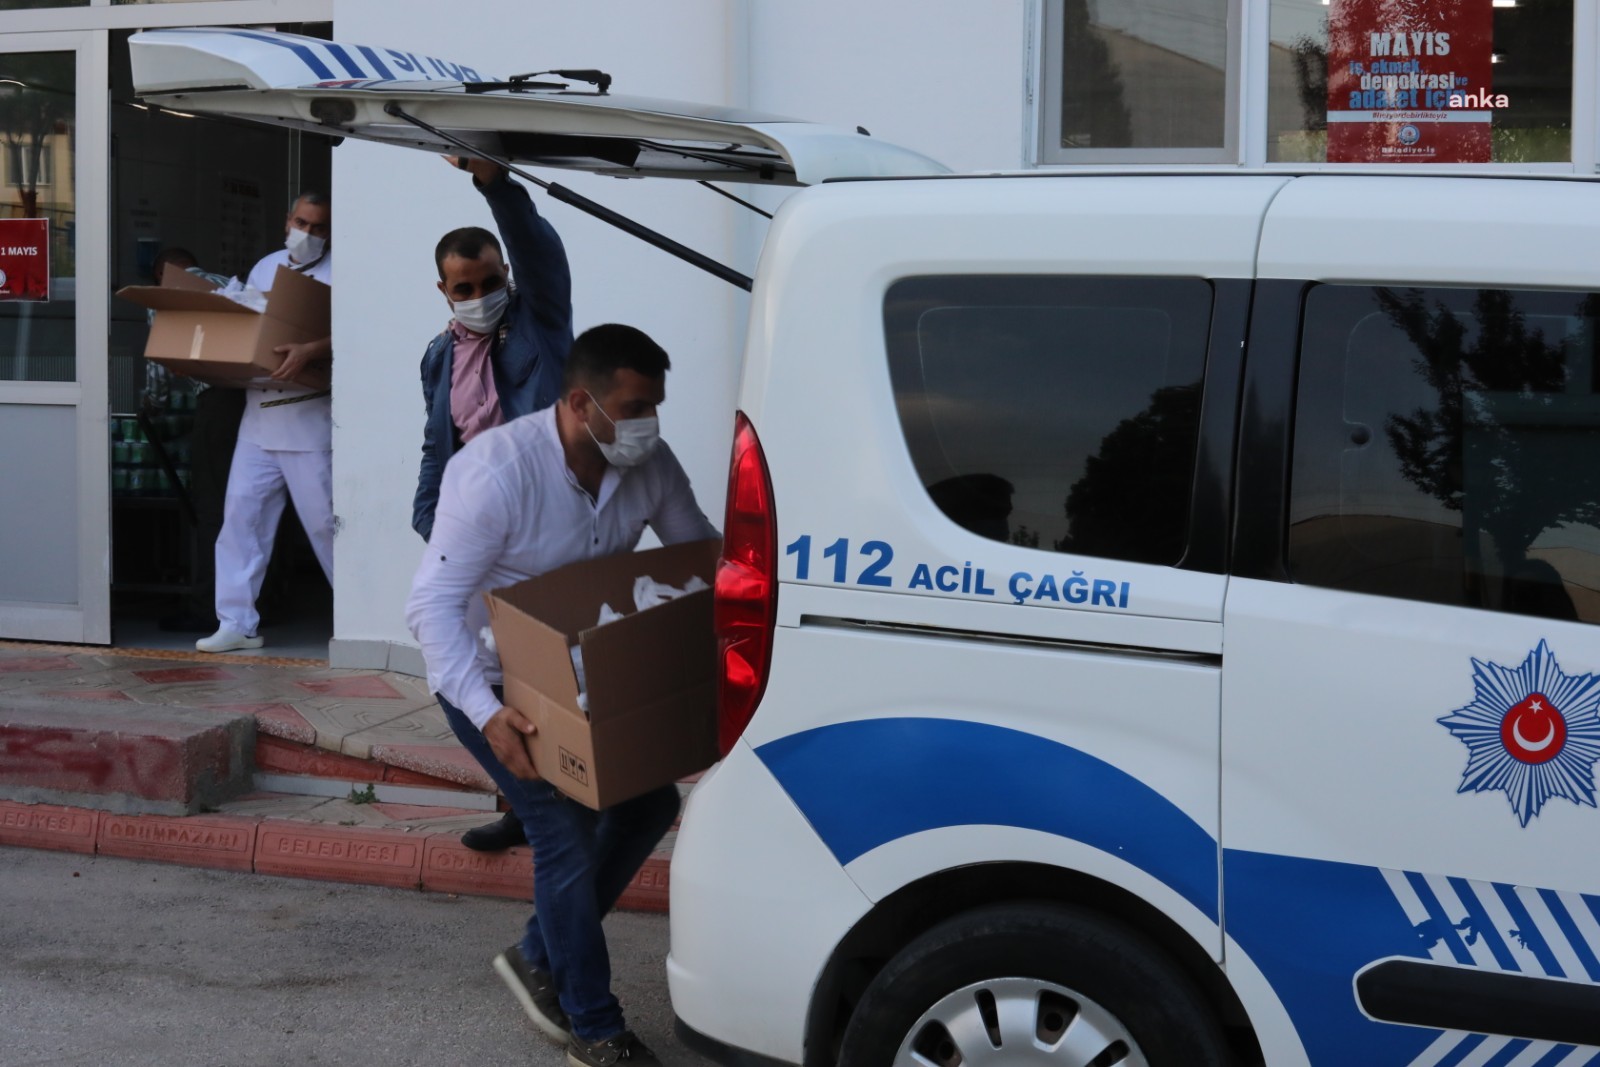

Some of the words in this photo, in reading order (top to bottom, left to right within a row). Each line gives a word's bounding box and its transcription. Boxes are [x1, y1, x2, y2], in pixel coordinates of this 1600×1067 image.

[1370, 31, 1450, 57] MAYIS
[1360, 71, 1455, 90] demokrasi
[1455, 75, 1468, 86] ve
[1, 247, 6, 256] 1
[8, 246, 38, 256] MAYIS
[786, 534, 894, 588] 112
[908, 561, 995, 596] ACİL
[1008, 570, 1131, 609] ÇAĞRI
